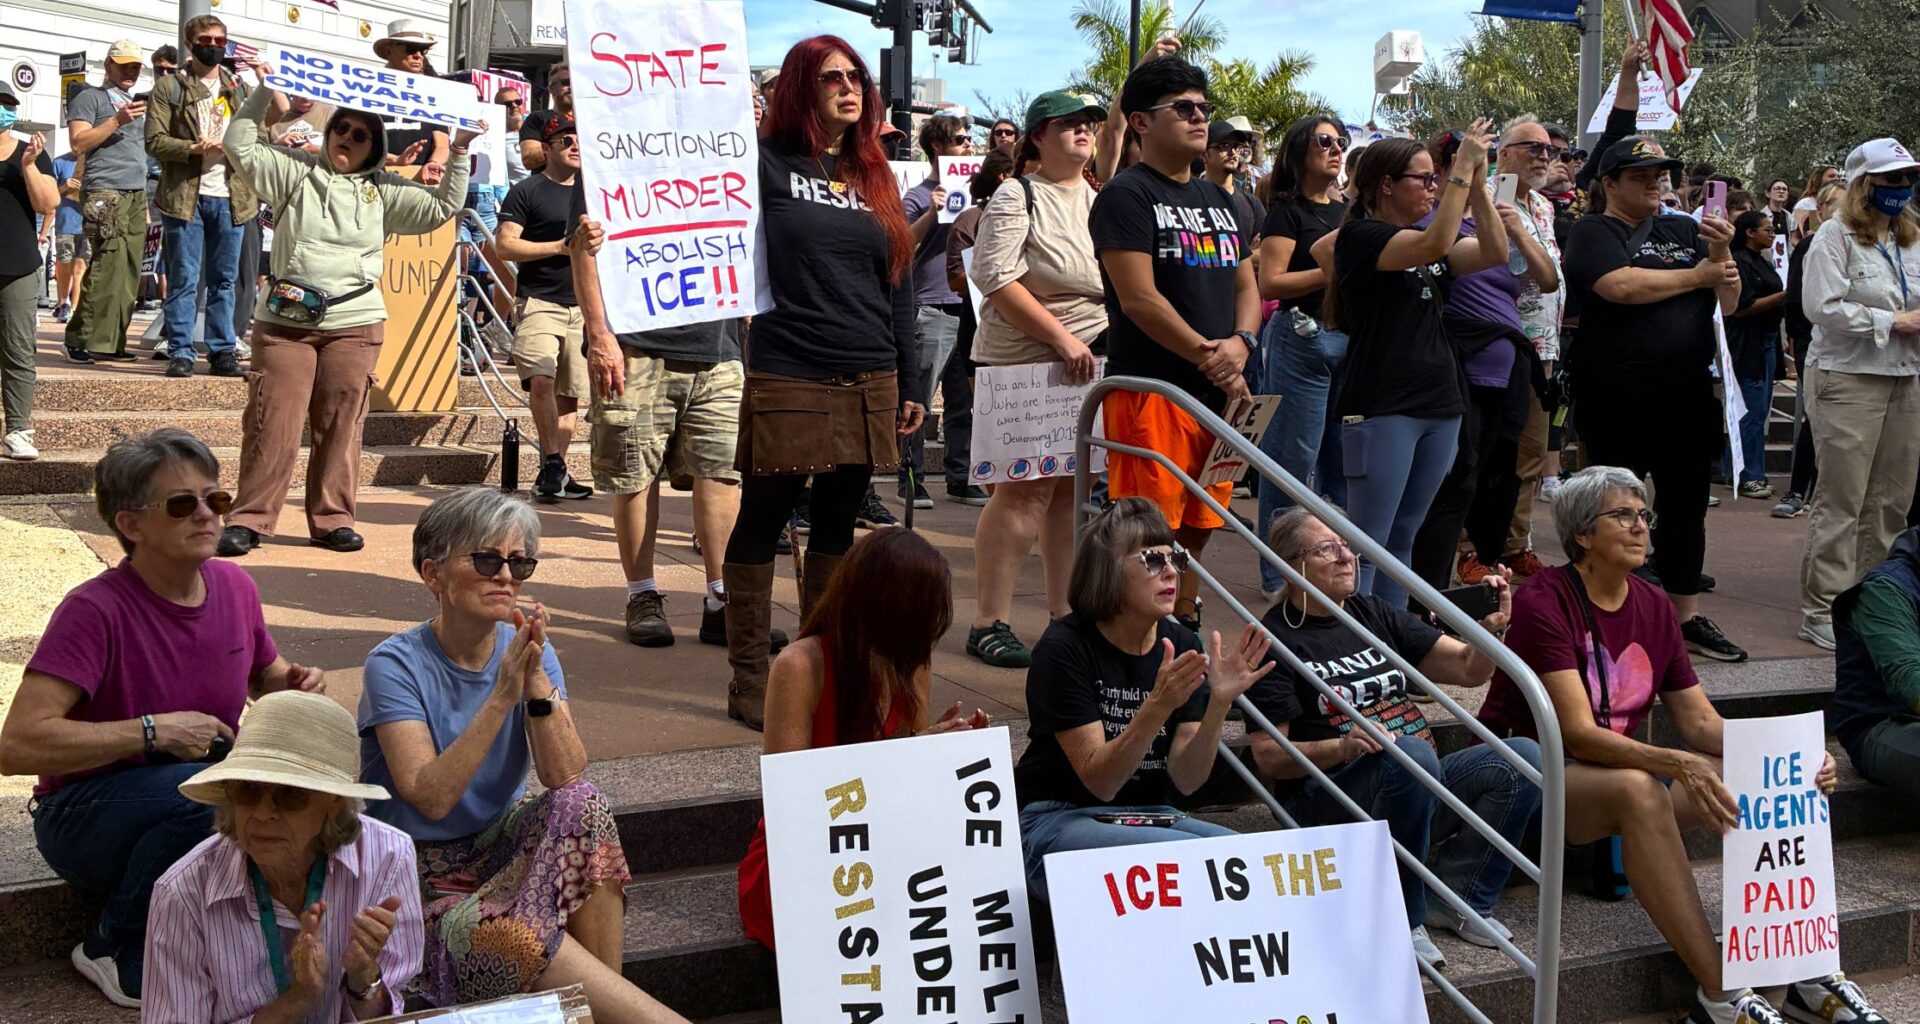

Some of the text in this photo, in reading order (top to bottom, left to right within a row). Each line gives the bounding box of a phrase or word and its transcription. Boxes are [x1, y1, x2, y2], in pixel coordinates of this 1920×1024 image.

[17, 69, 34, 83] GB
[280, 50, 333, 71] NO
[341, 63, 397, 86] ICE
[591, 32, 727, 97] STATE
[265, 75, 481, 130] ONLY PEACE
[280, 65, 437, 107] NO WAR!
[597, 131, 747, 160] SANCTIONED
[599, 171, 752, 222] MURDER
[1153, 202, 1183, 230] WE
[1176, 206, 1212, 234] ARE
[626, 231, 747, 273] ABOLISH
[381, 258, 444, 296] UMP
[979, 371, 1008, 416] You
[1011, 380, 1028, 390] are
[993, 396, 1019, 411] who
[1022, 398, 1039, 408] are
[996, 416, 1021, 427] were
[1110, 703, 1124, 718] the
[1122, 687, 1140, 701] told
[1763, 751, 1803, 789] ICE
[955, 757, 1002, 848] ICE
[1736, 790, 1828, 830] AGENTS
[1754, 835, 1806, 872] ARE
[1103, 847, 1343, 917] ICE IS THE
[1744, 876, 1816, 914] PAID
[907, 865, 958, 1024] UNDE
[1727, 914, 1838, 964] AGITATORS
[1193, 931, 1290, 987] NEW
